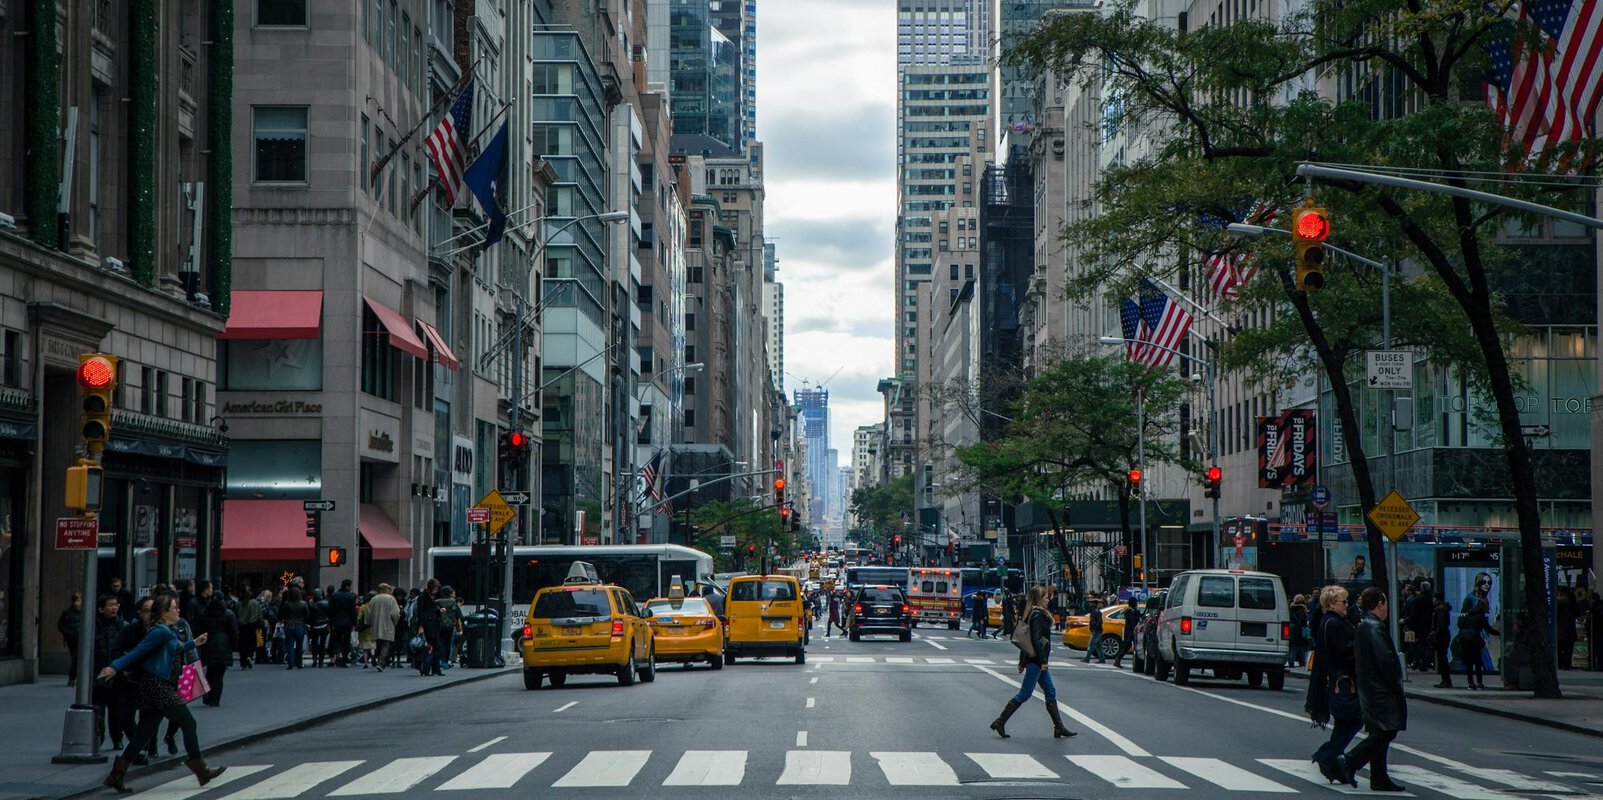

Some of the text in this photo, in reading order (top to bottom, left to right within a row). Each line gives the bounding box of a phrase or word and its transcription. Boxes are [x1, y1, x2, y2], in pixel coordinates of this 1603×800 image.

[1375, 354, 1404, 362] BUSES
[1378, 367, 1401, 375] ONLY
[222, 400, 322, 414] American Girl Place
[1436, 396, 1540, 414] TOPSOP
[1266, 432, 1278, 479] FRIDYS
[1293, 424, 1304, 476] FRIDAYS
